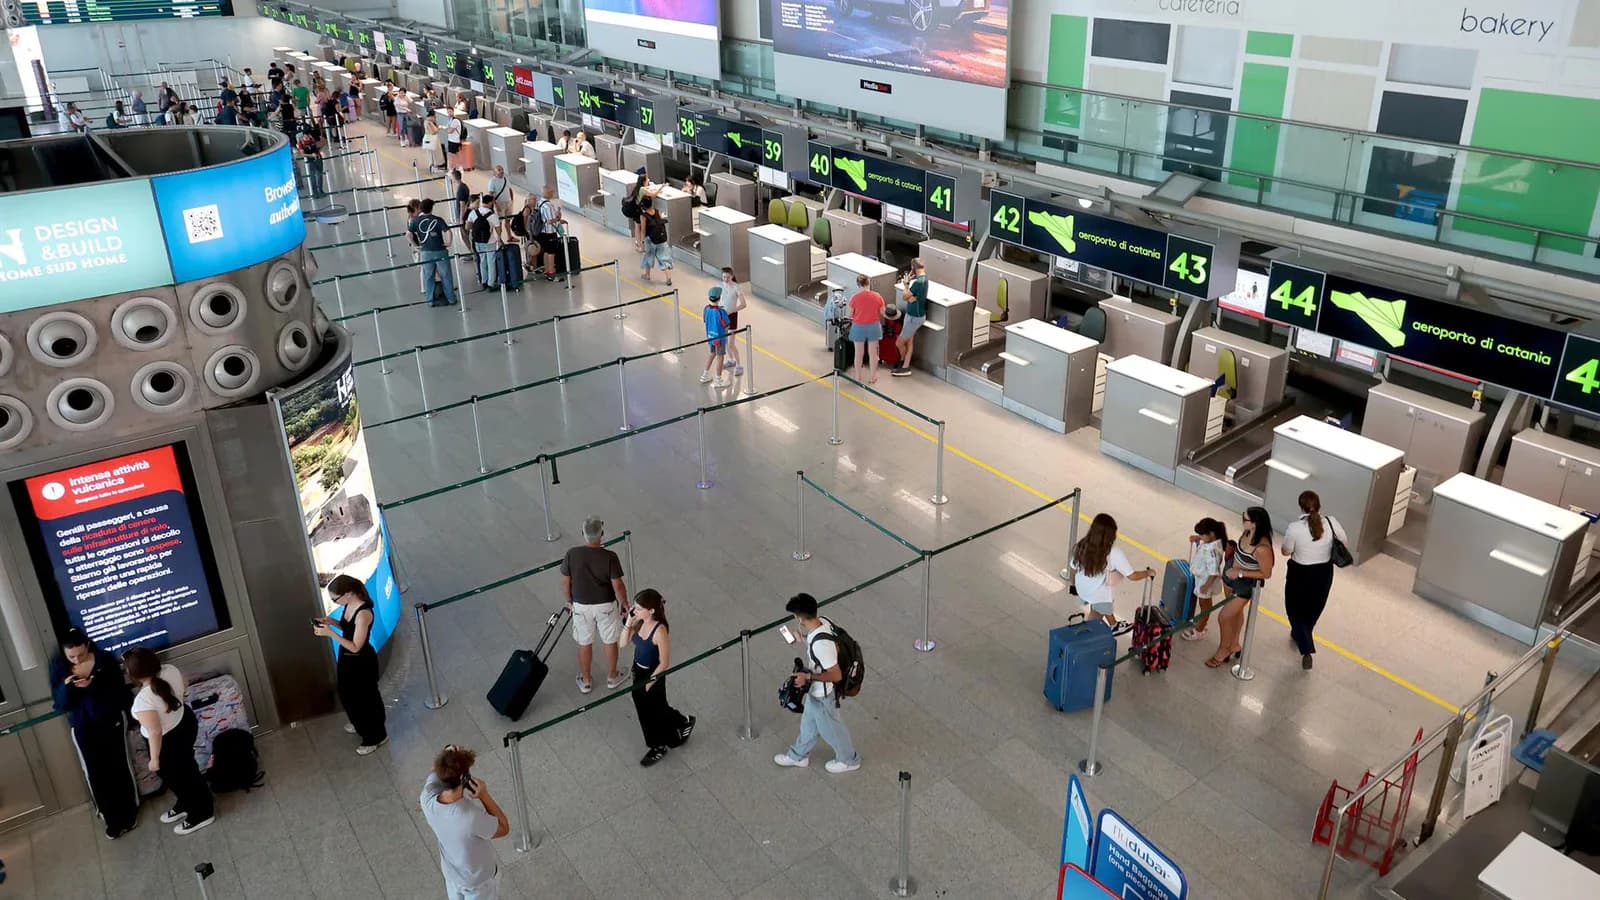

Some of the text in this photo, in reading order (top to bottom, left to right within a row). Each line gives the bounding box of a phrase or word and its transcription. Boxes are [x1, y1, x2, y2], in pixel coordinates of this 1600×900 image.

[1460, 8, 1553, 41] bakery
[429, 51, 438, 64] 32
[445, 55, 454, 69] 33
[484, 65, 494, 81] 34
[504, 70, 515, 87] 35
[579, 90, 591, 107] 36
[640, 107, 653, 125] 37
[680, 117, 695, 137] 38
[765, 139, 782, 161] 39
[810, 153, 829, 176] 40
[868, 172, 922, 193] aeroporto di catania
[930, 186, 951, 212] 41
[34, 216, 119, 241] DESIGN
[993, 205, 1021, 234] 42
[42, 235, 123, 261] &BUILD
[1078, 231, 1161, 259] aeroporto di catania
[46, 260, 77, 274] SUD
[81, 254, 128, 269] HOME
[1169, 252, 1207, 285] 43
[1270, 280, 1316, 317] 44
[1412, 321, 1552, 366] aeroporto di catania
[1565, 358, 1600, 395] 4
[69, 460, 151, 487] Intensa attività
[72, 478, 125, 496] vulcanica
[56, 524, 85, 538] Gentili
[86, 512, 136, 532] passeggeri,
[143, 503, 169, 516] causa
[59, 517, 157, 548] della ricaduta di cenere
[62, 544, 84, 556] sulle
[84, 531, 140, 550] infrastrutture
[140, 527, 149, 535] di
[64, 528, 181, 566] tutte le operazioni di decollo
[67, 566, 75, 574] e
[75, 554, 122, 573] atterraggio
[123, 548, 145, 559] sono
[70, 549, 174, 583] Stiamo già lavorando per
[73, 561, 163, 592] consentire una rapida
[75, 567, 174, 601] ripresa delle operazioni.
[1108, 844, 1131, 867] Hand
[1108, 855, 1125, 873] (one
[1125, 870, 1146, 890] piece
